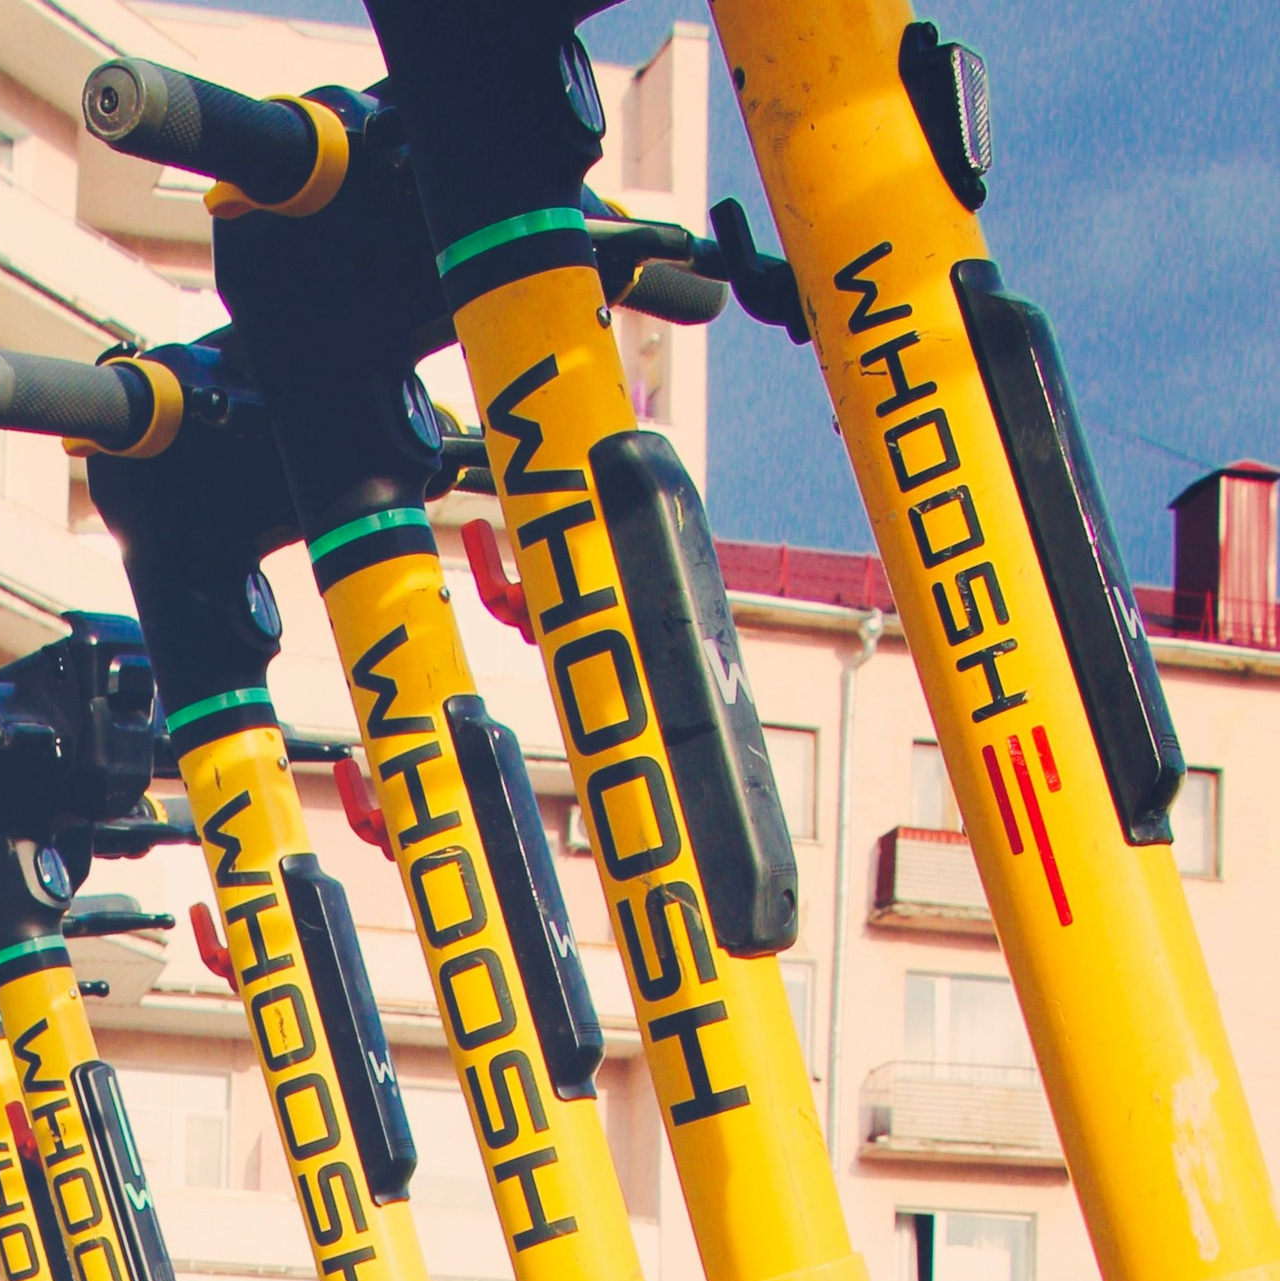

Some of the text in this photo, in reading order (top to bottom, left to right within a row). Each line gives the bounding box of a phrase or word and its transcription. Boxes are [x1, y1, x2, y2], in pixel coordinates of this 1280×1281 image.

[833, 240, 1032, 723] WHOOSH
[350, 622, 579, 1254] WHOOSH
[486, 353, 751, 1127] WHOOSH
[124, 1181, 154, 1212] W
[368, 1049, 394, 1085] W
